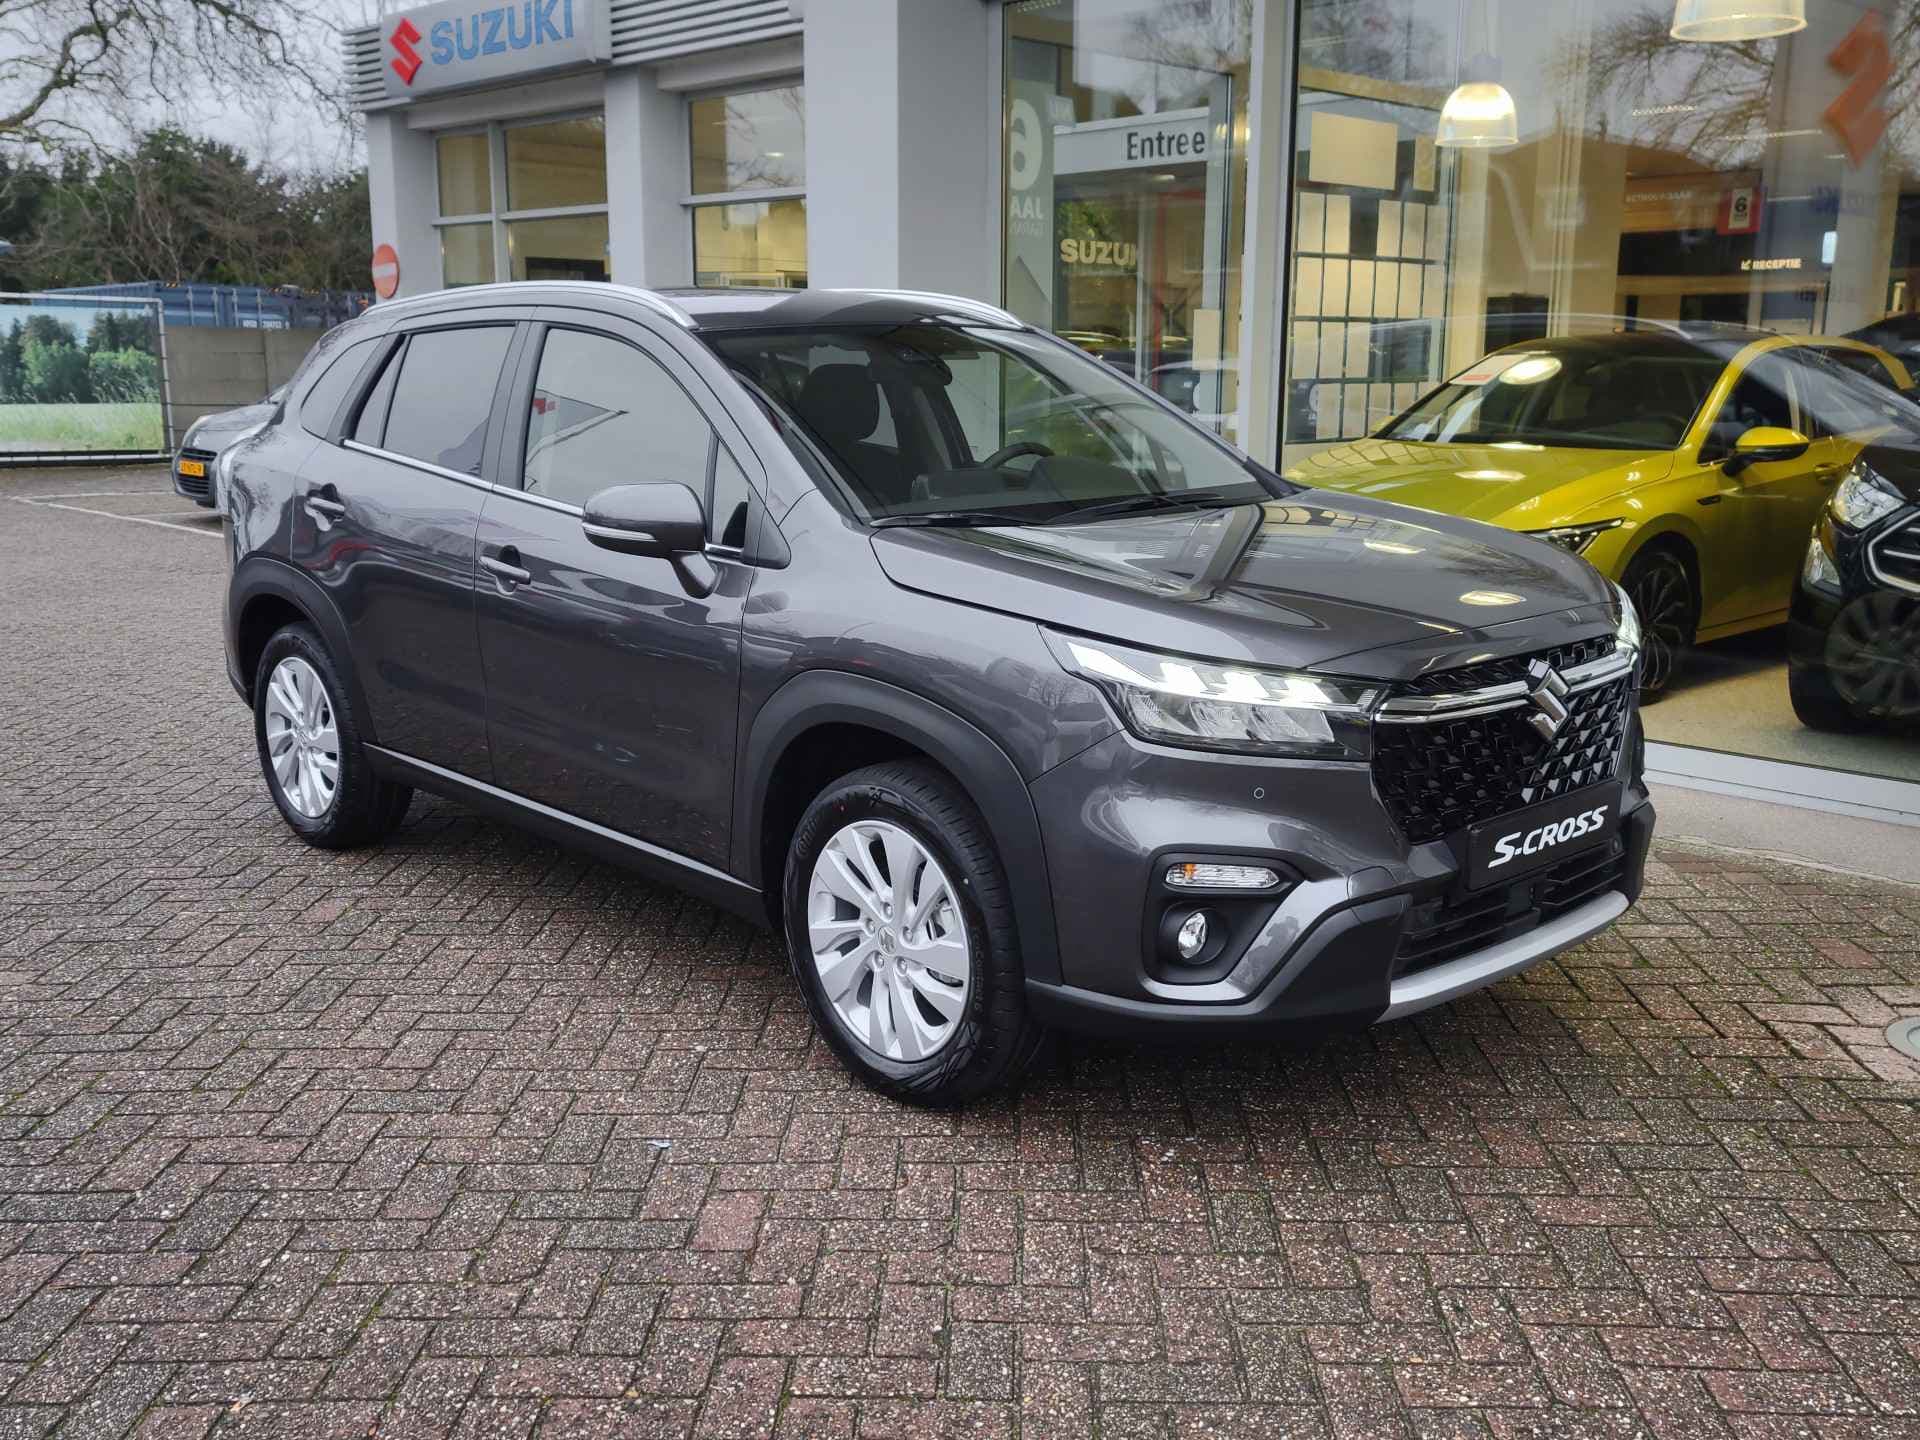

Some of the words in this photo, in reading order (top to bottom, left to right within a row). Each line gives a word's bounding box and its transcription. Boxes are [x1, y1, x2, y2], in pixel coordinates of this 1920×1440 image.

[431, 0, 574, 65] SUZUKI
[1127, 131, 1205, 160] Entree
[1488, 805, 1608, 868] S-CROSS
